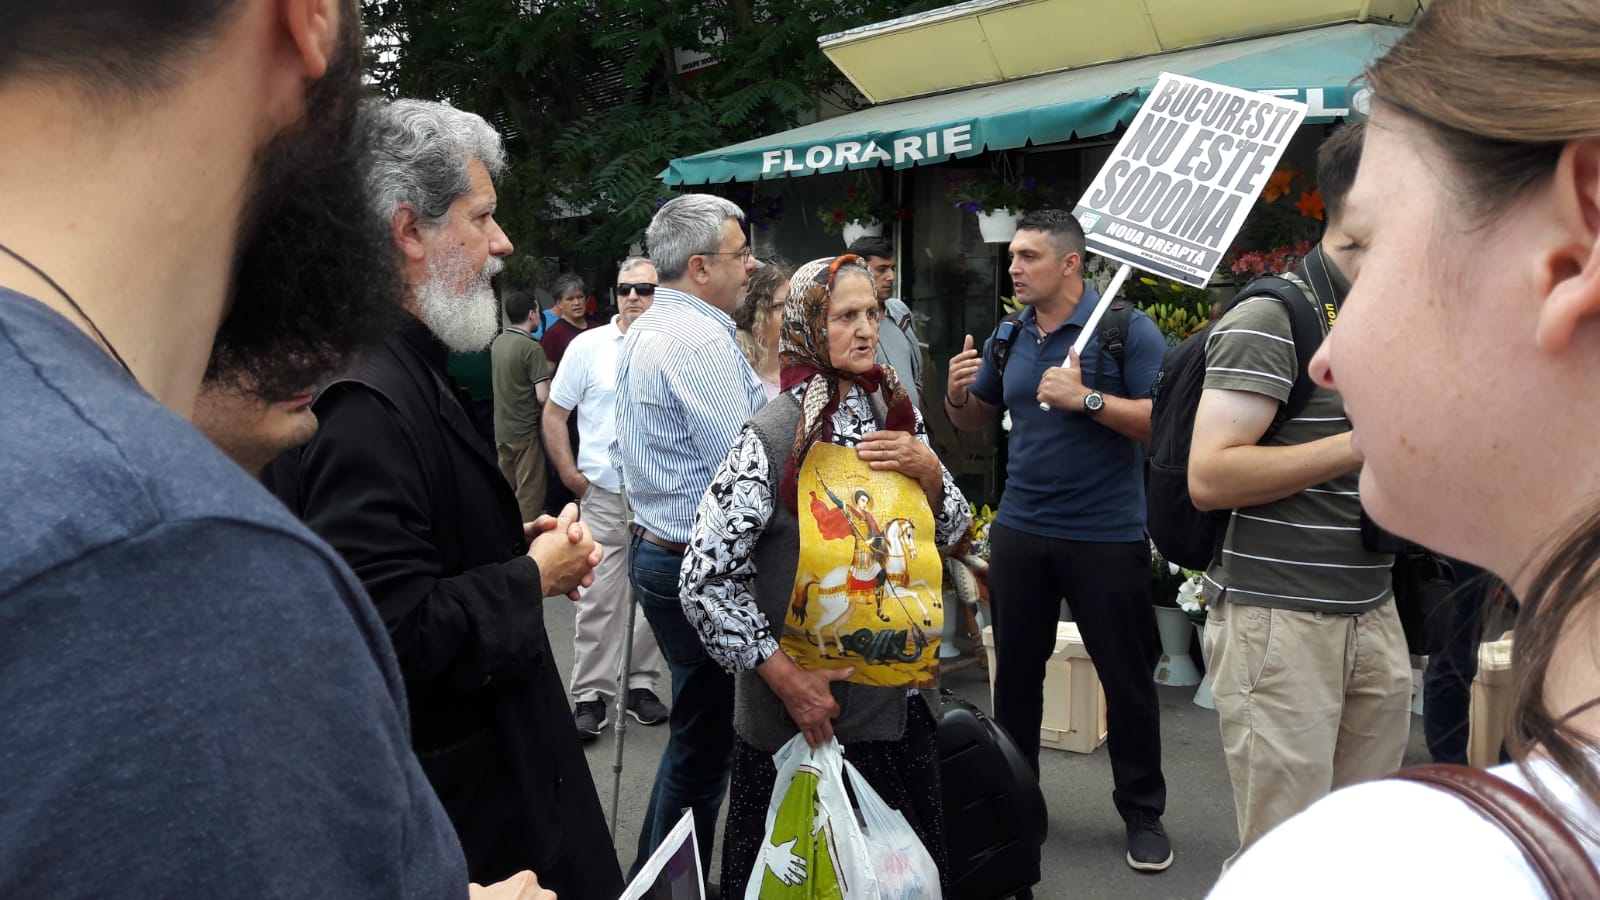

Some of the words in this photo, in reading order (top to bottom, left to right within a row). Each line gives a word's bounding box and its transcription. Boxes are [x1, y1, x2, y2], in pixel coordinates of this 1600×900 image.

[761, 124, 973, 174] FLORARIE
[1120, 112, 1190, 168] NU
[1174, 128, 1277, 195] ESTE
[1089, 159, 1243, 249] SODOMA
[1105, 221, 1142, 245] NOUA
[1143, 233, 1208, 266] DREAPTĂ
[1324, 303, 1337, 329] kon
